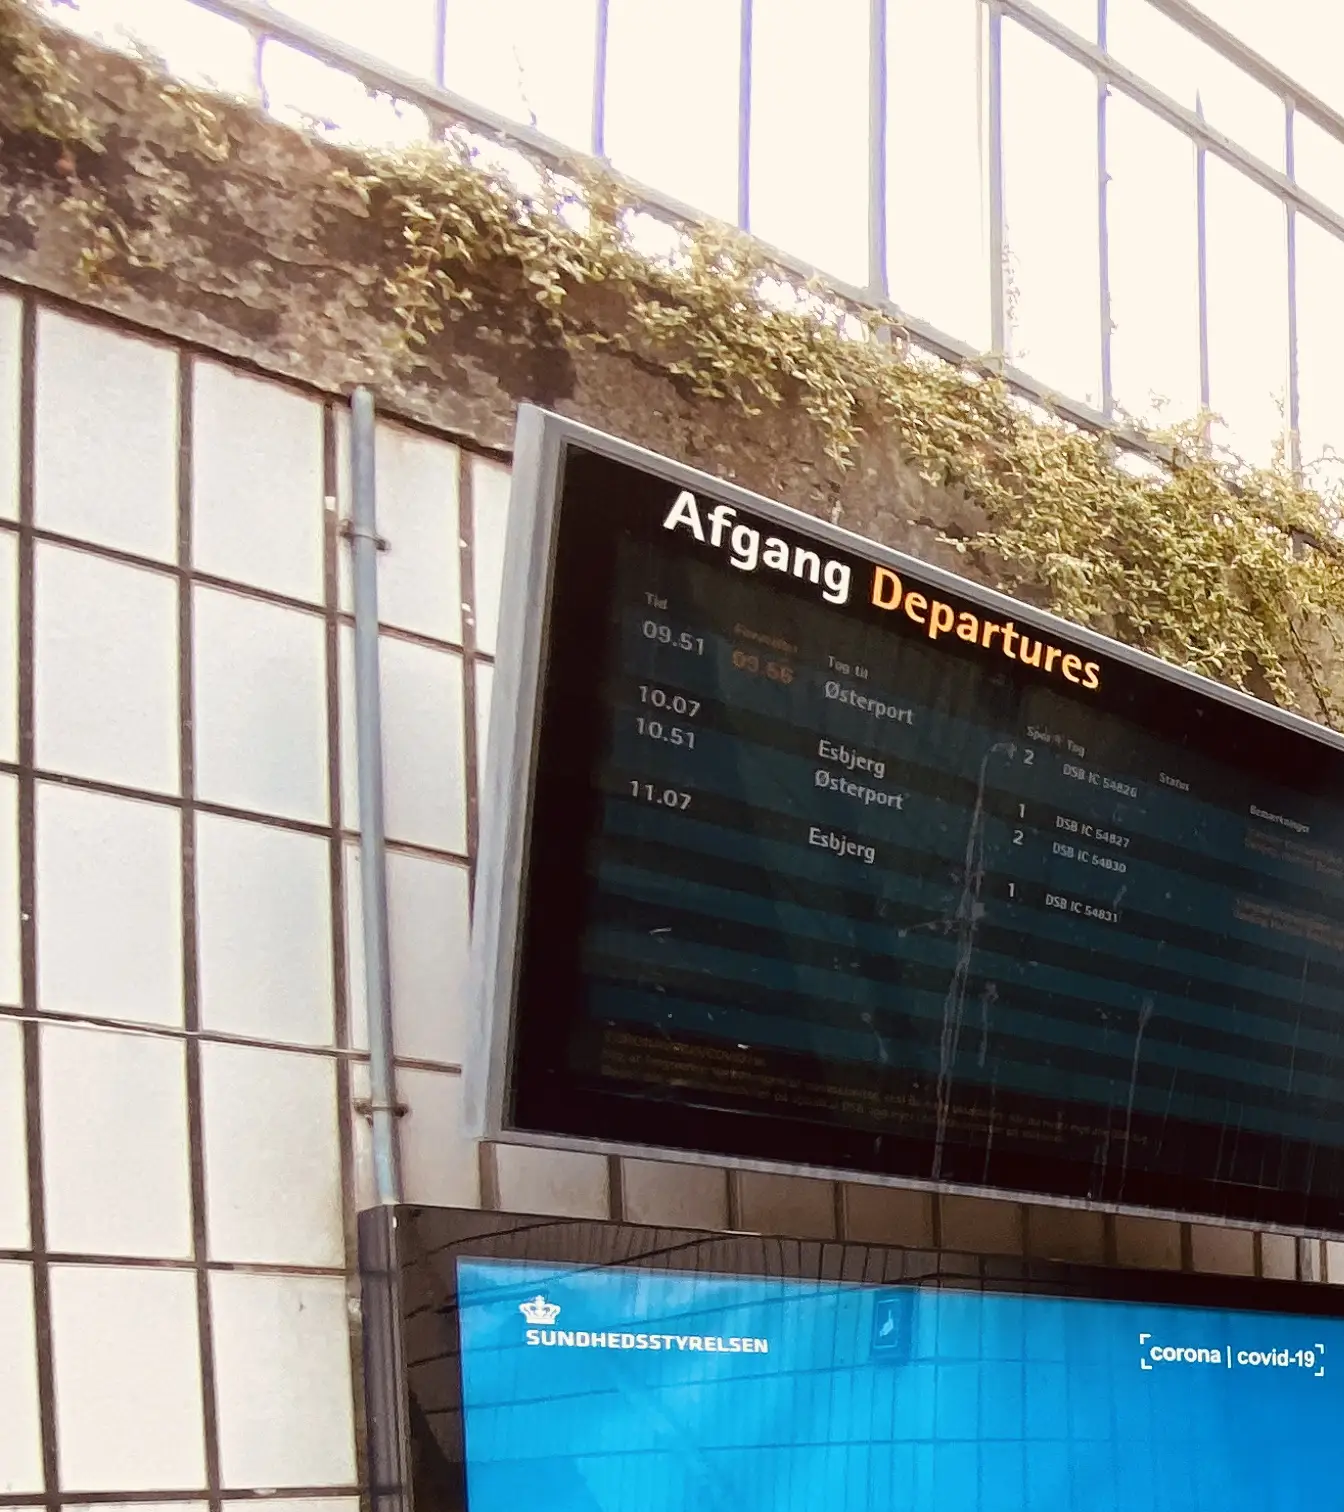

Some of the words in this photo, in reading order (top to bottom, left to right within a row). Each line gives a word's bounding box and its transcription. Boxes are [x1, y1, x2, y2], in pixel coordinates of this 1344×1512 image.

[645, 592, 668, 611] Tid
[662, 490, 852, 605] Afgang
[871, 564, 1101, 691] Departures
[641, 620, 705, 656] 09.51
[638, 684, 701, 719] 10.07
[824, 680, 914, 726] Østerport
[635, 717, 696, 750] 10.51
[817, 739, 887, 779] Esbjerg
[1023, 749, 1035, 766] 2
[1062, 763, 1086, 781] DSB
[1088, 771, 1101, 786] IC
[628, 779, 693, 812] 11.07
[813, 769, 904, 811] Østerport
[1018, 803, 1026, 819] 1
[1012, 829, 1025, 846] 2
[1055, 815, 1078, 833] DSB
[1081, 822, 1093, 838] IC
[808, 827, 877, 865] Esbjerg
[1052, 841, 1075, 859] DSB
[1077, 849, 1090, 864] IC
[1008, 882, 1016, 898] 1
[1045, 893, 1067, 910] DSB
[1070, 901, 1083, 915] IC
[526, 1329, 769, 1353] SUNDHEDSSTYRELSEN
[1150, 1345, 1222, 1364] corona
[1237, 1347, 1315, 1368] covid-19
